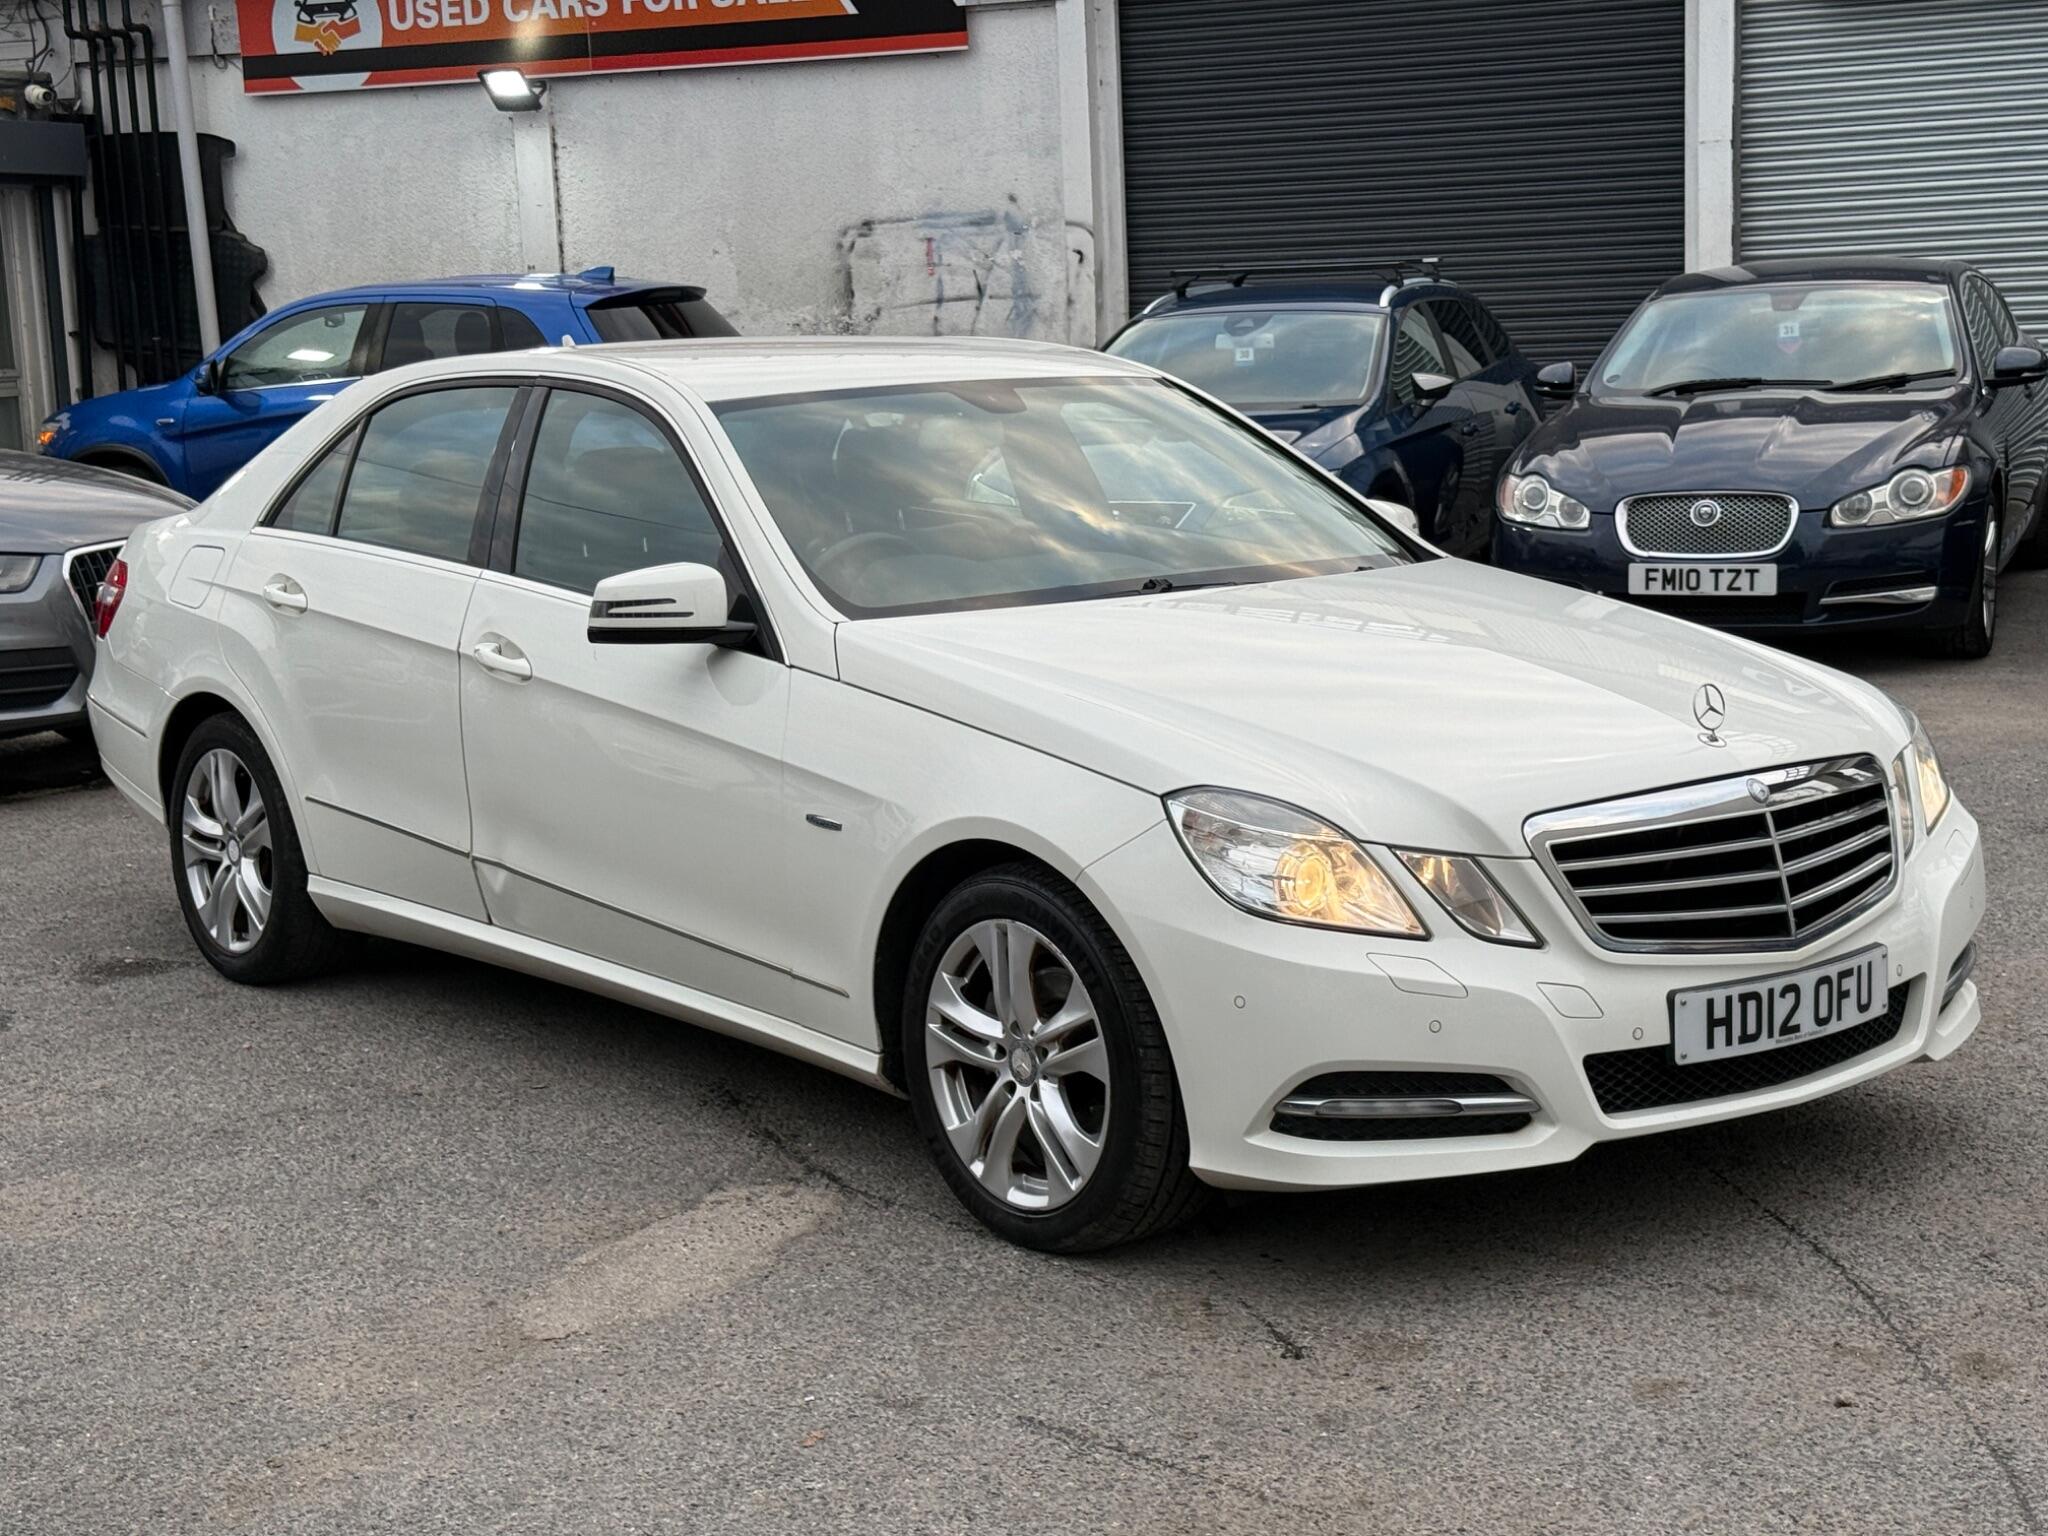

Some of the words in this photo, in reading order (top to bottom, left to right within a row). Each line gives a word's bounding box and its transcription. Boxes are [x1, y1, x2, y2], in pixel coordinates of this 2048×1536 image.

[388, 0, 490, 31] USED
[1645, 568, 1700, 591] FM10
[1709, 568, 1760, 591] TZT
[1706, 983, 1801, 1050] HD12
[1813, 961, 1873, 1027] OFU
